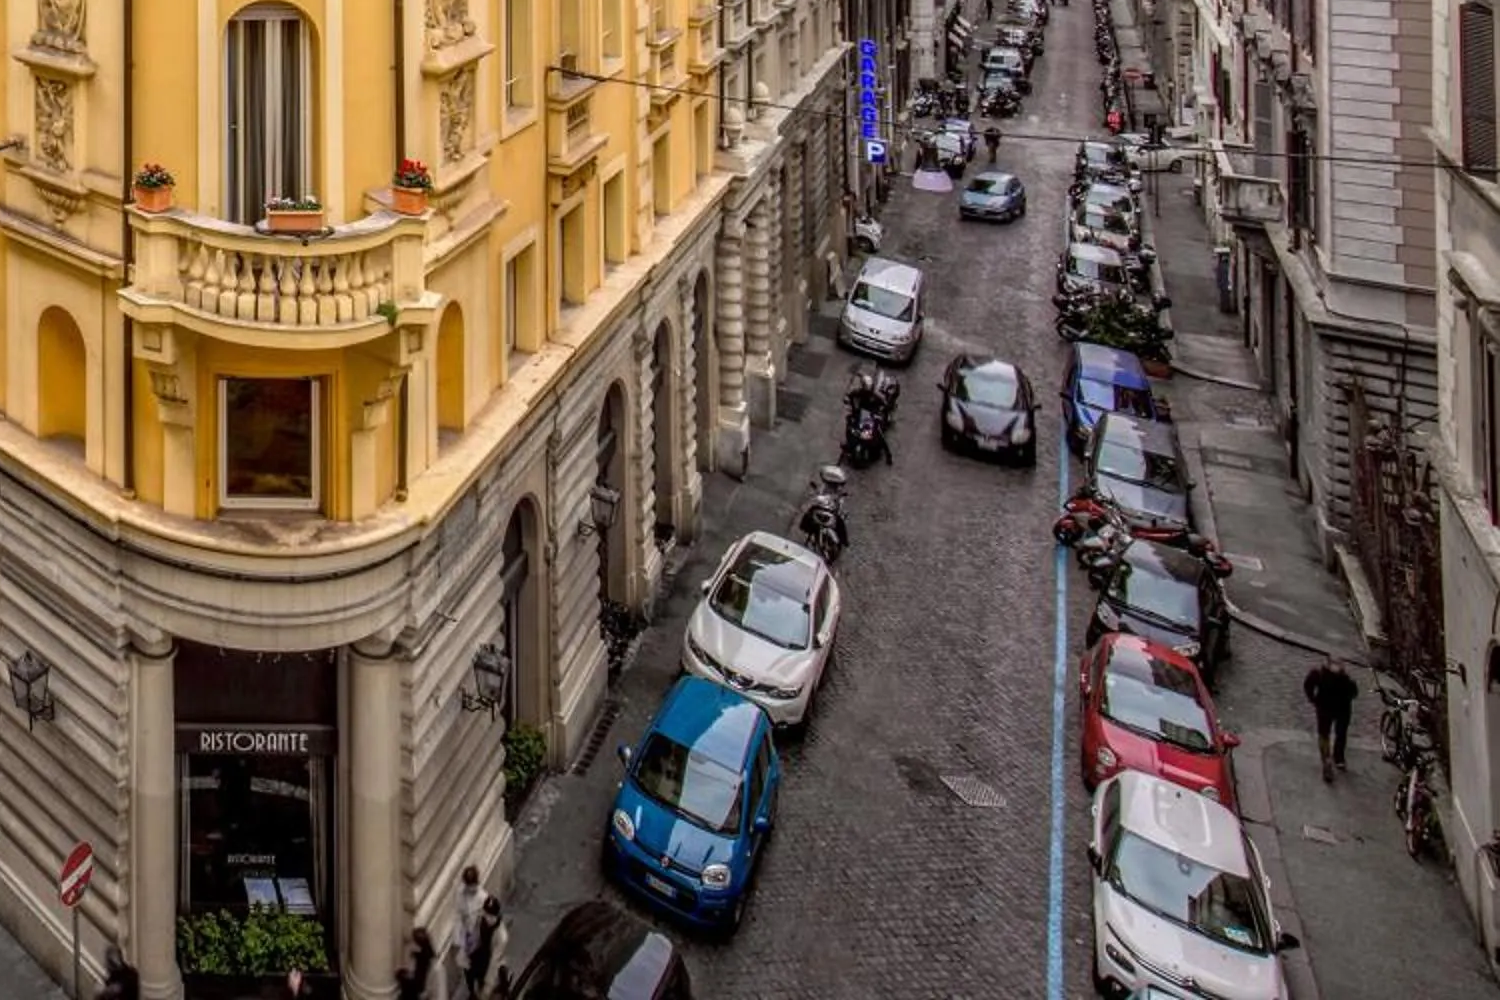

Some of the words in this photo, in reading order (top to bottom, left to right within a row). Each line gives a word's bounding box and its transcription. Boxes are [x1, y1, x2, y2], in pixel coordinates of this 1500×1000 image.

[861, 39, 877, 138] GARAGE
[867, 141, 885, 161] P
[200, 731, 309, 752] RISTORANTE
